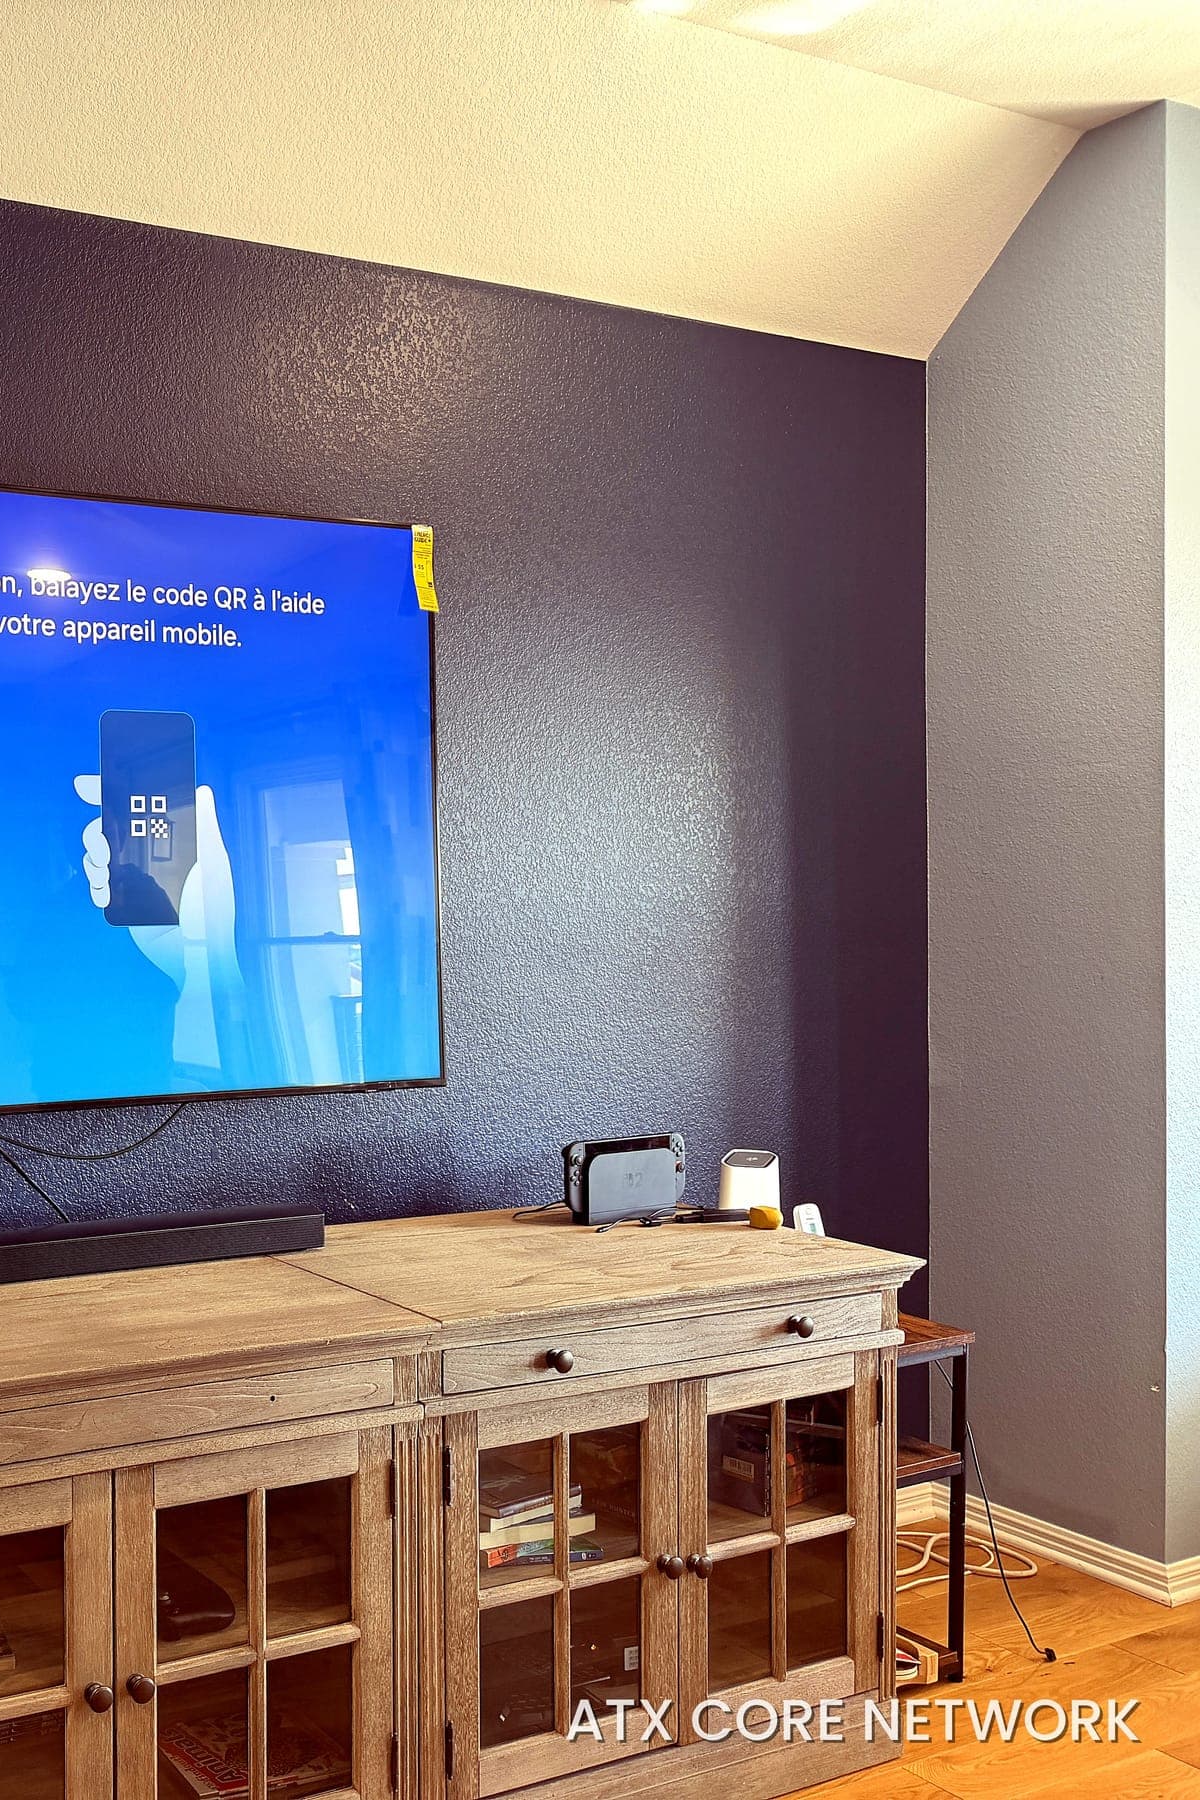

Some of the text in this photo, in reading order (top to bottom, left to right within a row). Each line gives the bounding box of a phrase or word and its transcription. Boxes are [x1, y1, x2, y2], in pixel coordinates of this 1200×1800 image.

[30, 569, 121, 605] balayez
[126, 578, 147, 603] le
[152, 583, 208, 607] code
[214, 586, 247, 611] QR
[253, 587, 266, 611] à
[271, 589, 325, 615] l'aide
[62, 619, 156, 645] appareil
[162, 622, 242, 648] mobile.
